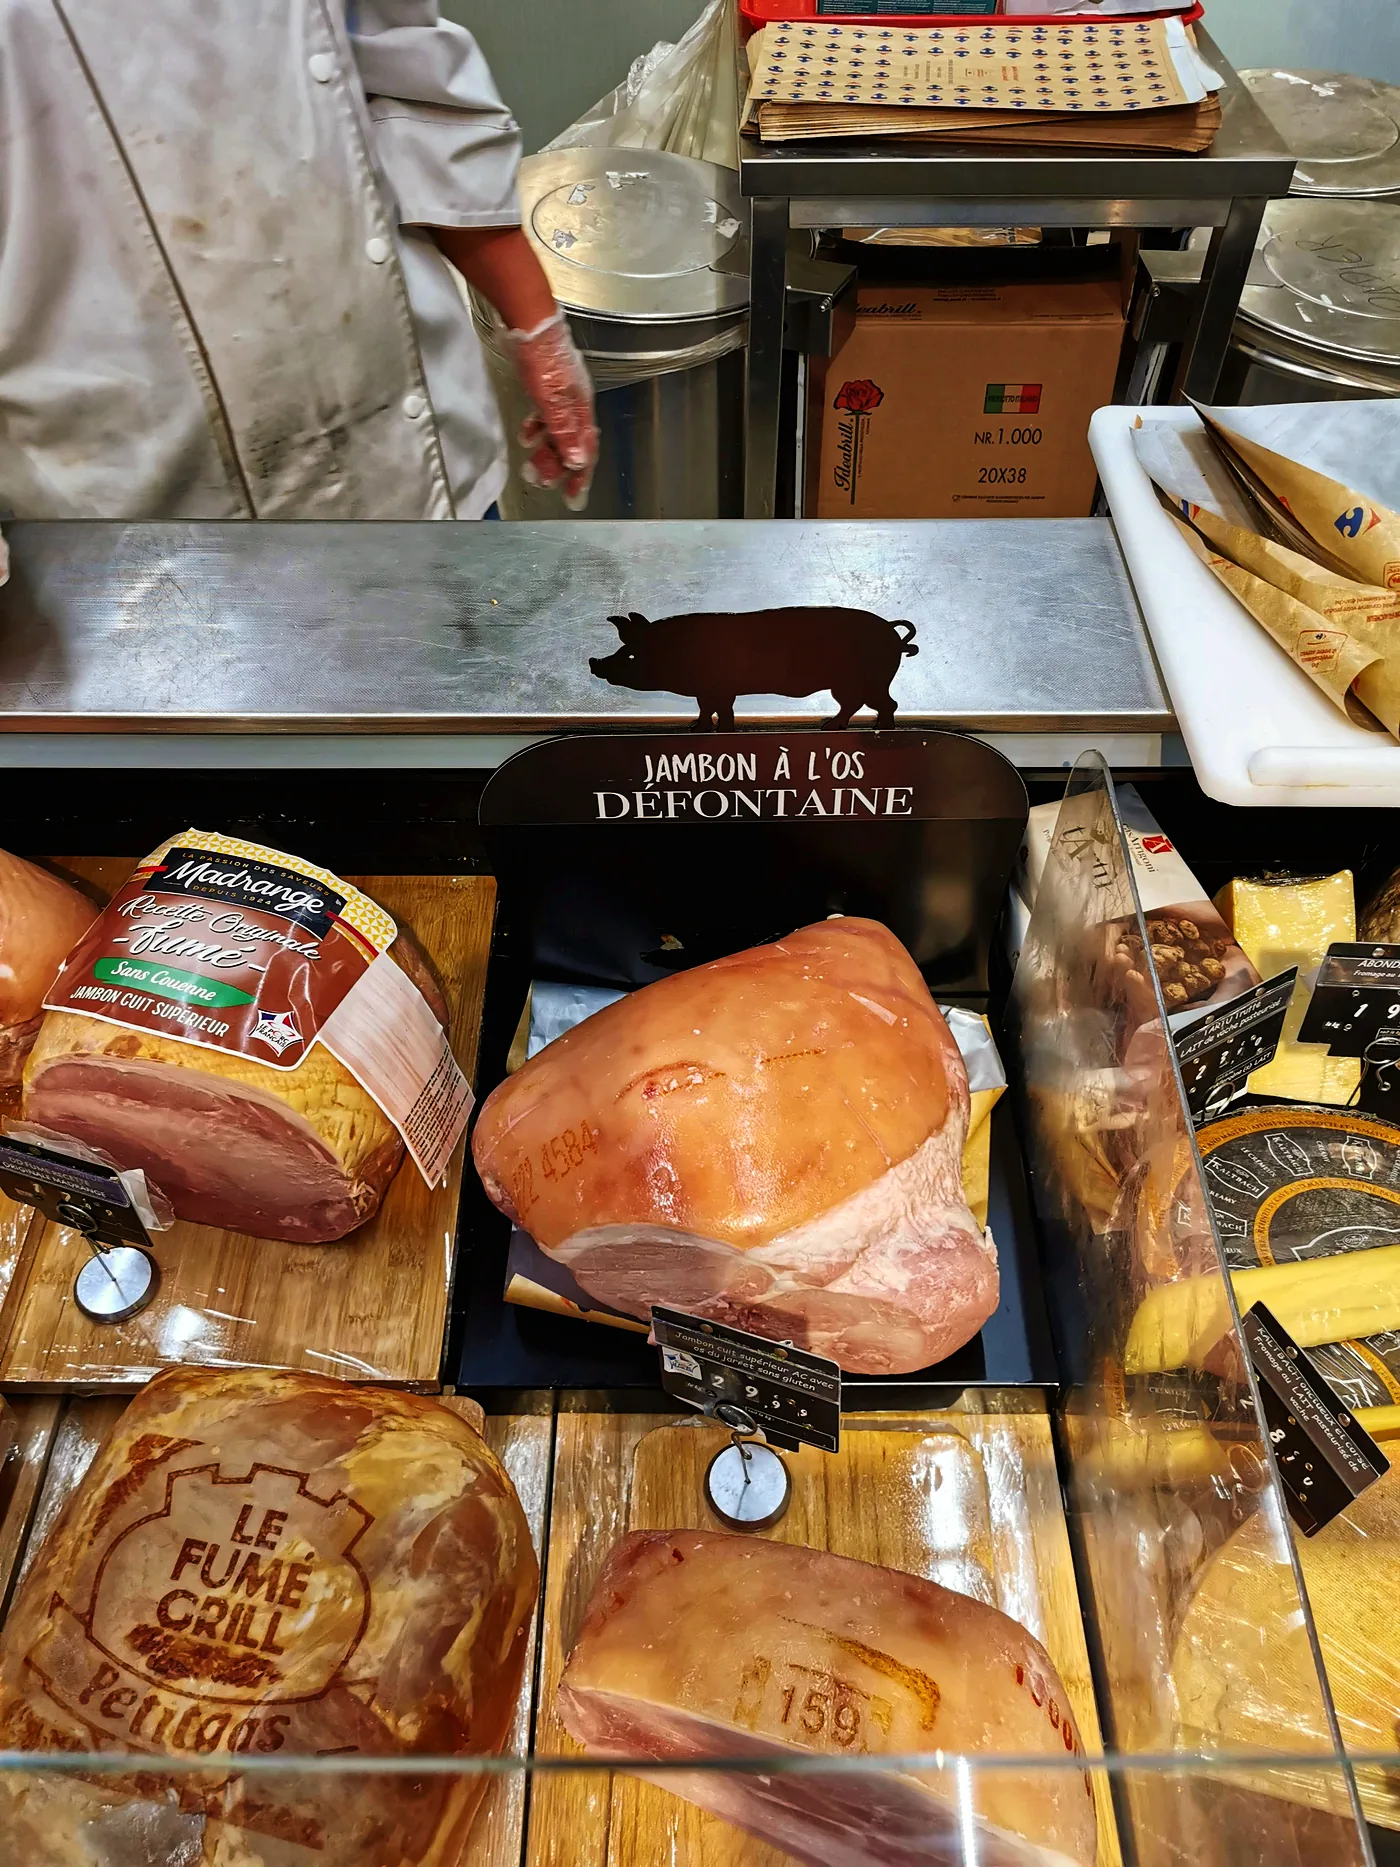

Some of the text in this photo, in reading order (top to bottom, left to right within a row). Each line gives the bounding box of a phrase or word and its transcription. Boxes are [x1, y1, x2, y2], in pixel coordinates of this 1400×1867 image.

[977, 467, 1028, 485] 20X38
[642, 746, 866, 784] JAMBON À L'OS
[592, 782, 915, 820] DÉFONTAINE
[163, 860, 325, 915] Madrange
[192, 885, 272, 906] DEPUIS 1924
[199, 855, 250, 868] PASSION
[253, 865, 275, 874] DES
[280, 872, 330, 897] SAVEURS
[118, 893, 323, 961] Recette Originale
[110, 961, 217, 1001] Sans Couenne
[1358, 960, 1400, 969] ABOND
[70, 985, 231, 1039] JAMBON CUIT SUPÉRIEUR
[1180, 1040, 1205, 1058] LAIT
[1272, 1136, 1305, 1174] KALTBACH
[1212, 1161, 1260, 1193] KALTBACH
[675, 1331, 836, 1391] Jambon cuit supérieur AC avec
[693, 1346, 706, 1354] os
[707, 1349, 721, 1359] du
[757, 1367, 781, 1380] sans
[782, 1374, 817, 1392] gluten
[1256, 1326, 1302, 1382] KALTBACH
[1299, 1382, 1336, 1427] onctueux
[1253, 1336, 1360, 1473] Fromage au LAIT pasteurisé de
[1288, 1396, 1311, 1423] vache
[230, 1503, 289, 1551] LE
[169, 1536, 316, 1609] FUMÉ
